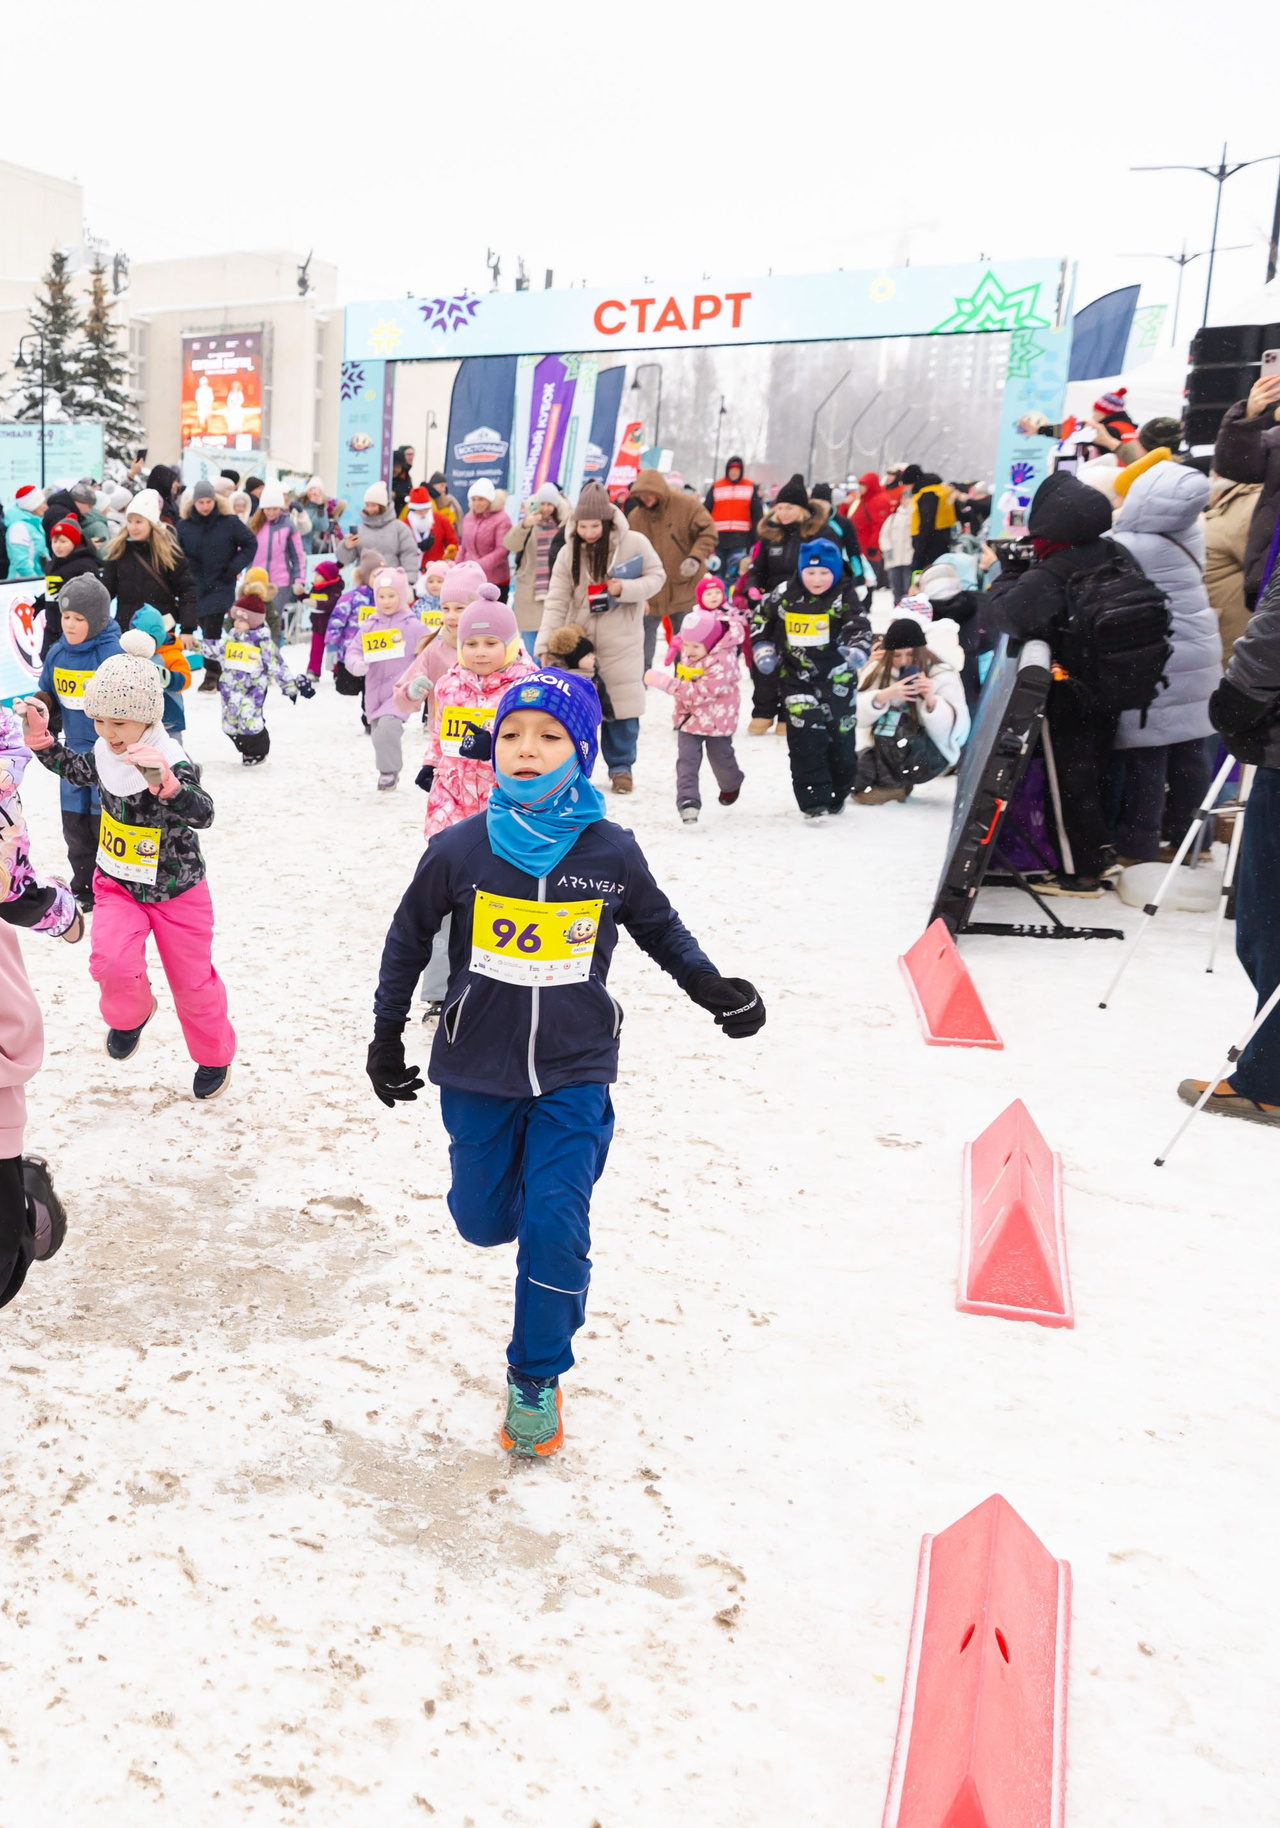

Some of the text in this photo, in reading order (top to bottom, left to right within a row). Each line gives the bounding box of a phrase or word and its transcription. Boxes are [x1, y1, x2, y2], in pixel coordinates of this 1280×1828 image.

[593, 292, 752, 335] СТАРТ
[788, 621, 810, 634] 107
[366, 637, 388, 651] 126
[227, 648, 244, 660] 144
[56, 678, 77, 694] 109
[446, 719, 472, 738] 117
[101, 825, 126, 858] 120
[492, 918, 542, 954] 96
